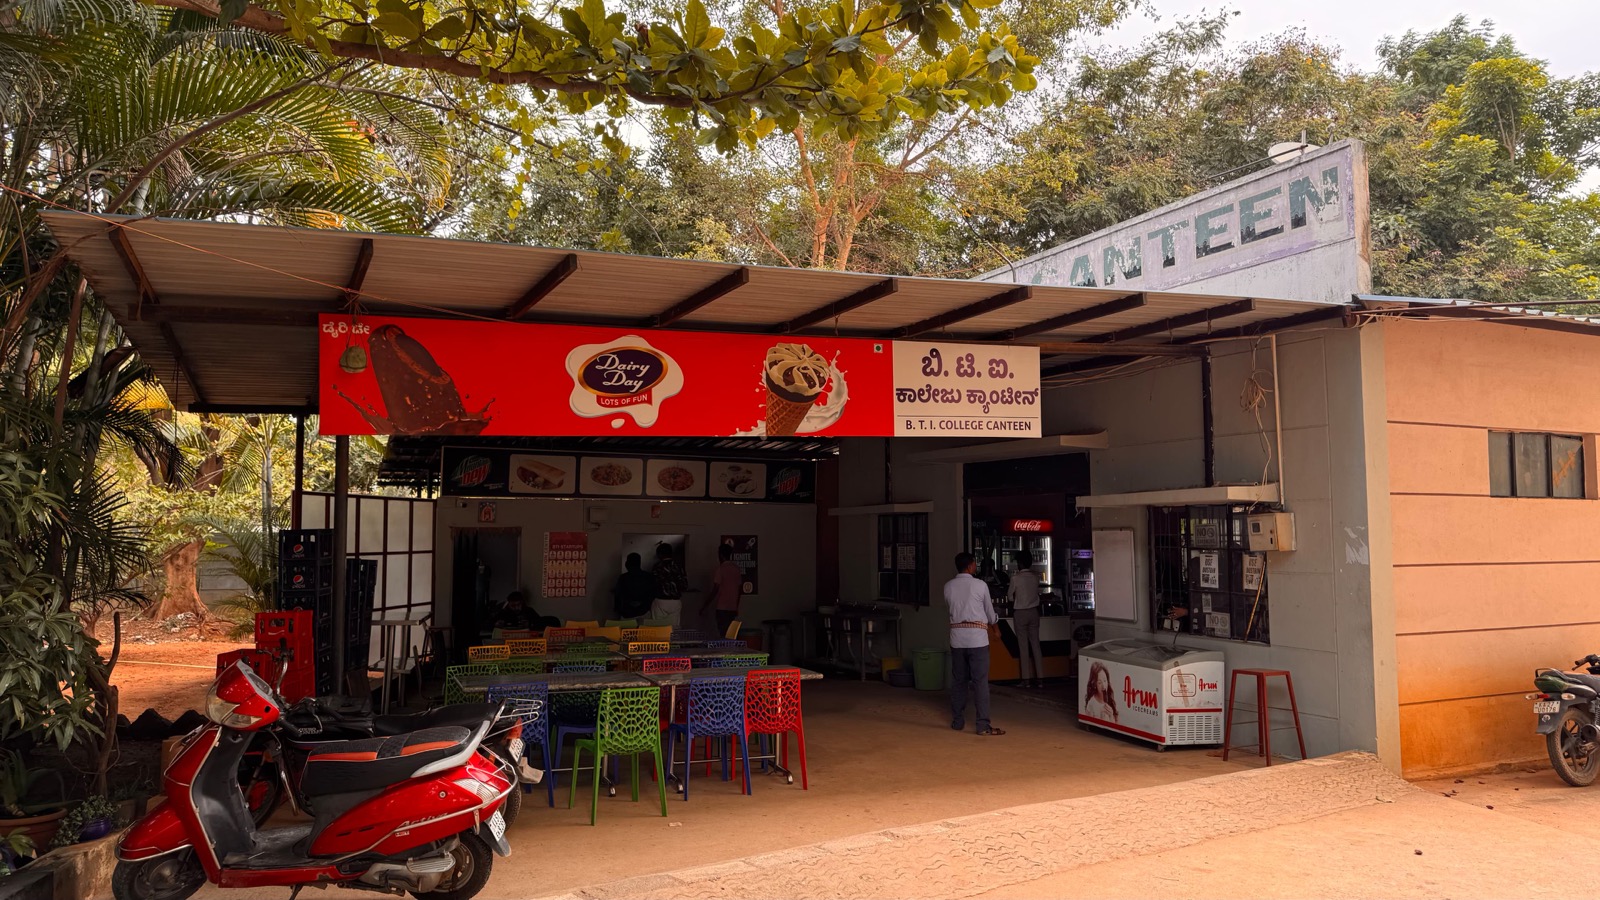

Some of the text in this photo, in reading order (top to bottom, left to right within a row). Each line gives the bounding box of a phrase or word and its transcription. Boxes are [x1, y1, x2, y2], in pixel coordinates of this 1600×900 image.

[595, 353, 650, 377] Dairy
[956, 352, 982, 378] ಟಿ.
[602, 369, 644, 393] Day
[600, 393, 648, 406] LOTS OF FUN
[895, 384, 962, 404] ಕಾಲೇಜು
[906, 420, 1031, 431] B. T. I. COLLEGE CANTEEN
[1196, 527, 1206, 537] NO
[1123, 676, 1158, 709] Arun
[1198, 678, 1217, 692] Arun
[1132, 705, 1159, 717] ICECREAMS
